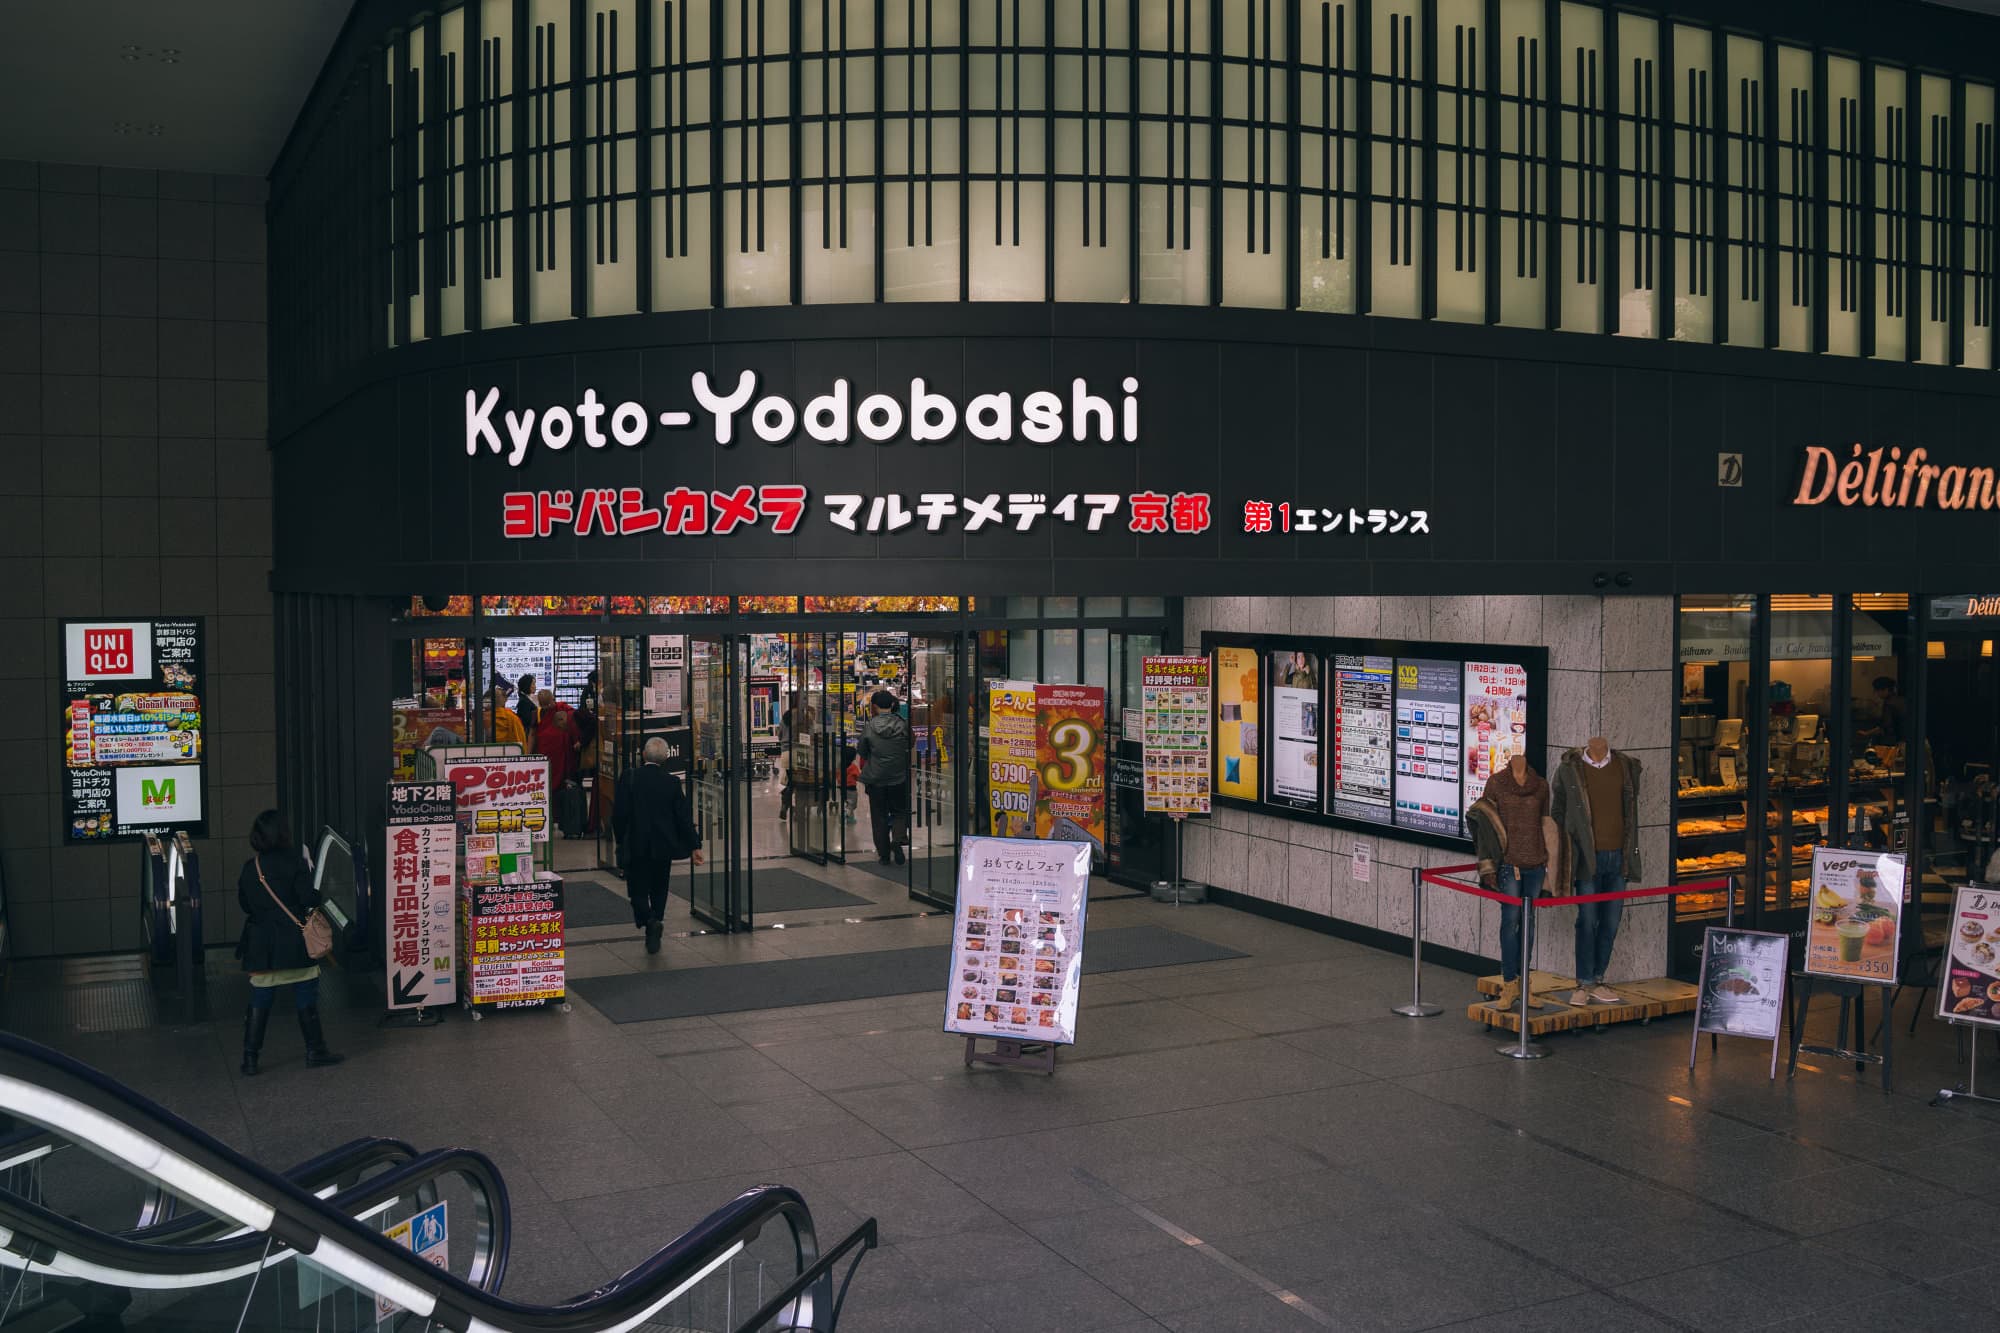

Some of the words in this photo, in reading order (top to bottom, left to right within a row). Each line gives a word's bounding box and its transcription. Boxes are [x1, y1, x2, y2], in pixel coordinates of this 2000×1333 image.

[466, 369, 1139, 467] Kyoto-Yodobashi
[1792, 442, 2000, 510] Délifran
[503, 484, 807, 538] ヨドバシカメラ
[90, 634, 125, 651] UNI
[156, 637, 196, 647] 専門店の
[161, 648, 192, 658] ご案内
[90, 653, 128, 672] QLO
[1145, 664, 1207, 674] 写真で送る年賀状
[1398, 665, 1418, 677] KYO
[1145, 675, 1194, 685] 好評受付中!
[1485, 685, 1513, 696] 4日間は
[163, 697, 195, 709] Kitchen
[72, 778, 110, 788] ヨドチカ
[449, 766, 545, 794] POINT
[71, 788, 111, 798] 専門店の
[391, 785, 452, 802] 地下2階
[456, 781, 545, 807] NETWORK
[77, 799, 107, 809] ご案内
[392, 803, 452, 815] YodoChika
[475, 808, 547, 834] 最新号
[983, 857, 1065, 872] おもてなしフェア
[1823, 859, 1858, 872] Vege
[393, 828, 420, 967] 食料品売場
[478, 915, 506, 924] 2014年
[477, 921, 561, 938] 写真で送る年賀状
[475, 938, 562, 954] 早割キャンペーン中
[480, 963, 513, 971] FUJIFILM
[496, 998, 546, 1009] ヨドバシカメラ
